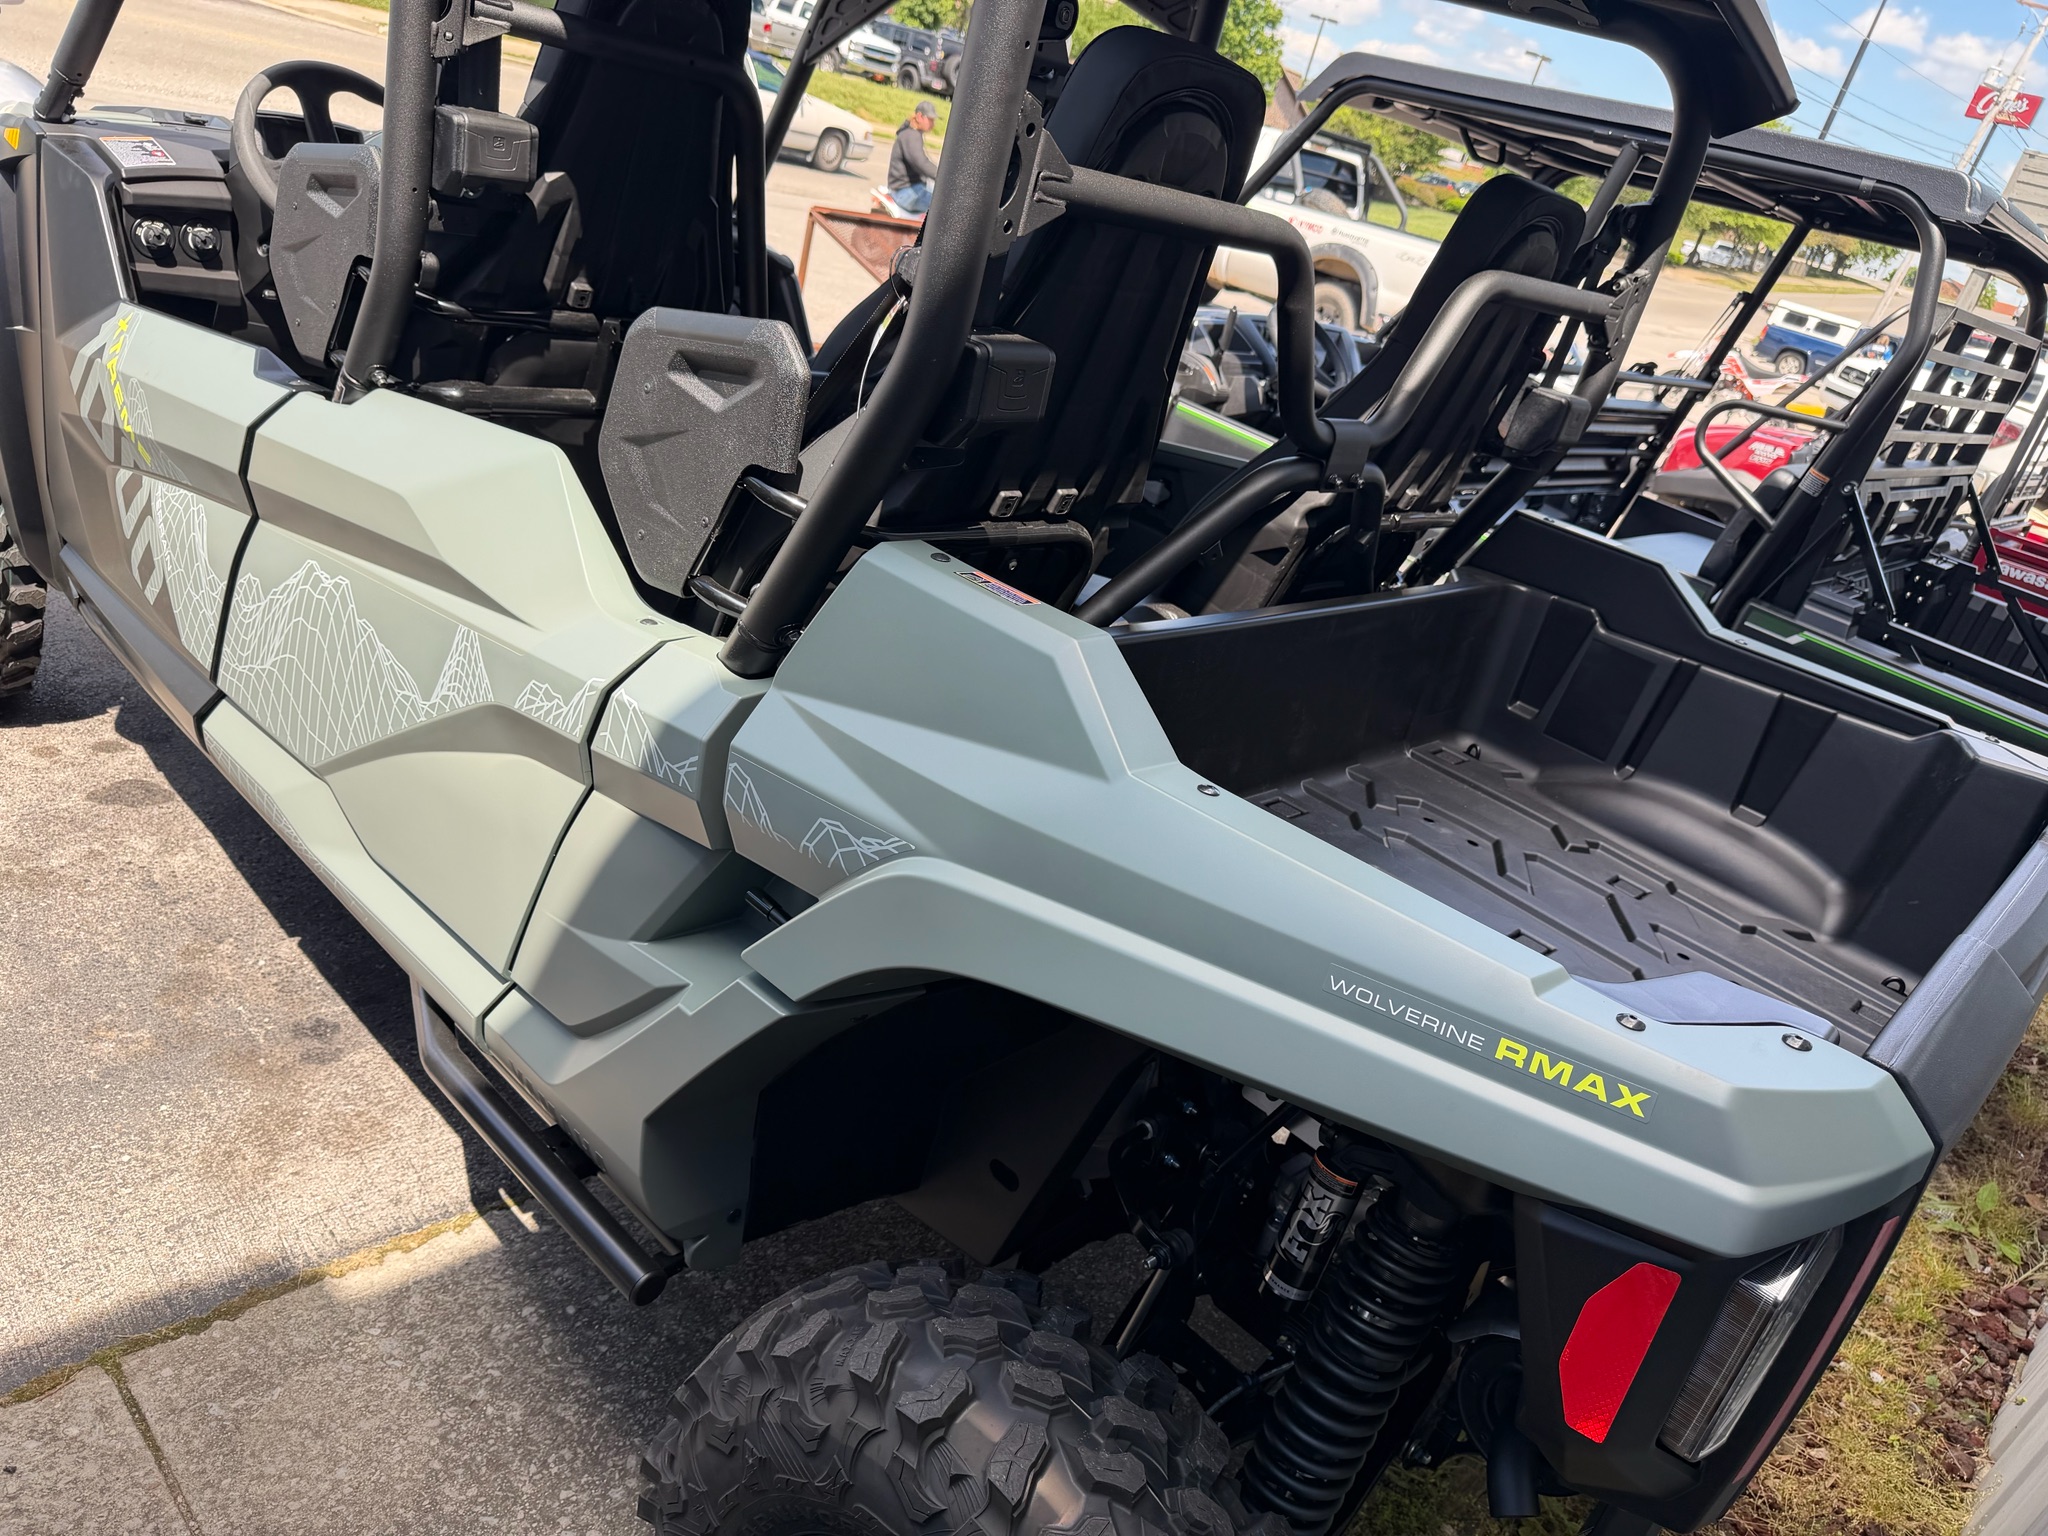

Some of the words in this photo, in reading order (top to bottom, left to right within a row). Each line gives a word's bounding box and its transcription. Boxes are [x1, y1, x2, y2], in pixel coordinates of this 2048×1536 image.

[1330, 974, 1486, 1051] WOLVERINE
[1494, 1037, 1652, 1118] RMAX
[1280, 1181, 1334, 1264] FOX
